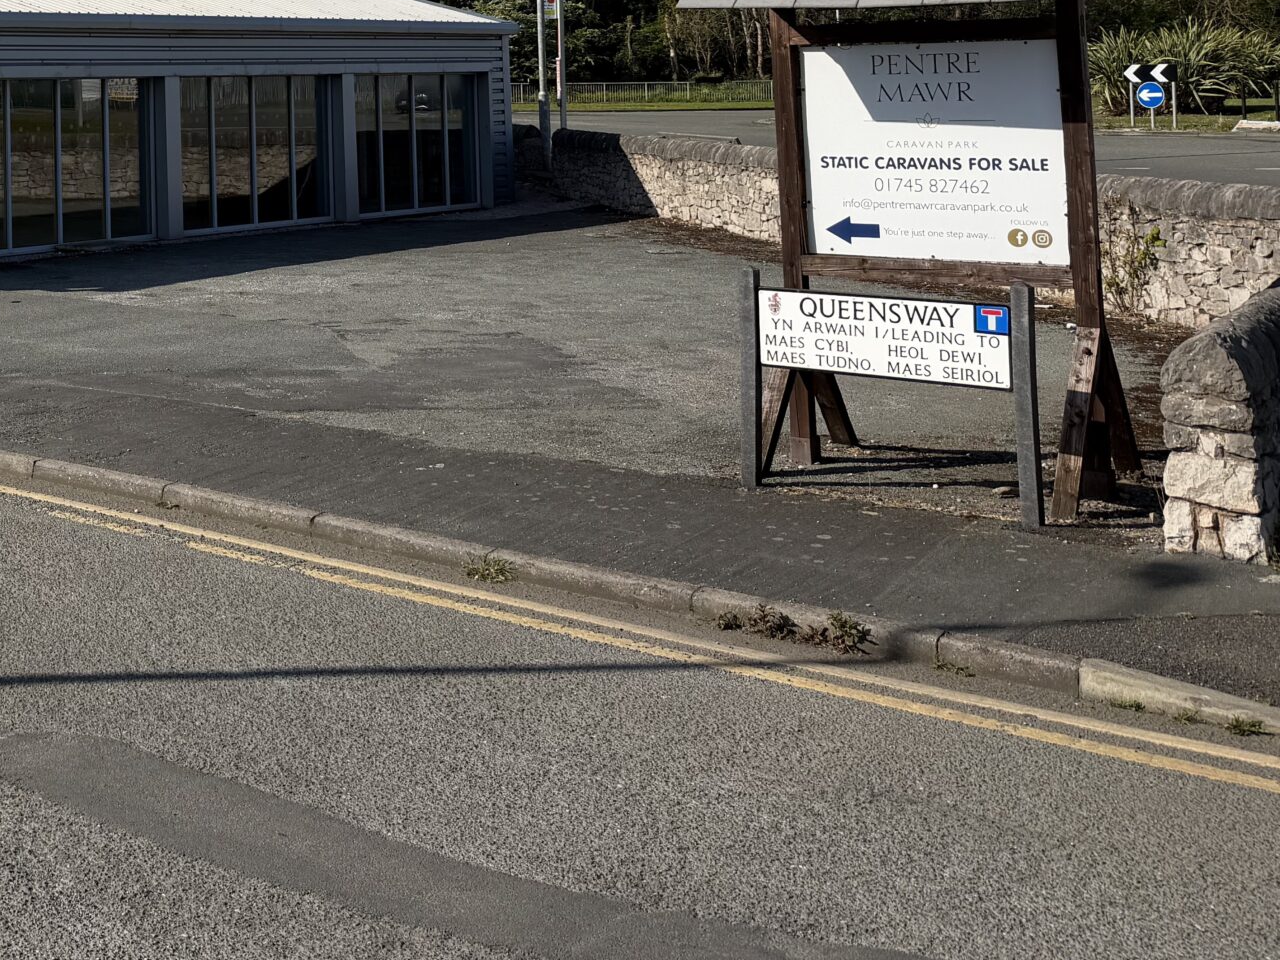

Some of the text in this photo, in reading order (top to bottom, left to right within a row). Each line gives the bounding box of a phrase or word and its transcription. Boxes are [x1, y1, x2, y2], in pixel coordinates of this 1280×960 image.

[870, 52, 981, 75] PENTRE
[876, 81, 975, 103] MAWR
[886, 140, 979, 149] CARAVAN PARK
[820, 156, 1049, 172] STATIC CARAVANS FOR SALE
[874, 178, 990, 195] 01745 827462
[842, 198, 1029, 214] info@pentremawrcaravanpark.co.uk
[883, 227, 909, 237] You're
[911, 227, 925, 238] just
[947, 230, 963, 240] step
[799, 297, 960, 328] QUEENSWAY
[771, 318, 793, 331] YN
[803, 321, 865, 337] ARWAIN
[976, 335, 1000, 349] TO
[765, 333, 805, 349] MAES
[888, 344, 928, 360] HEOL
[766, 349, 806, 365] MAES
[887, 361, 932, 377] MAES
[942, 366, 1004, 384] SEIRIOL
